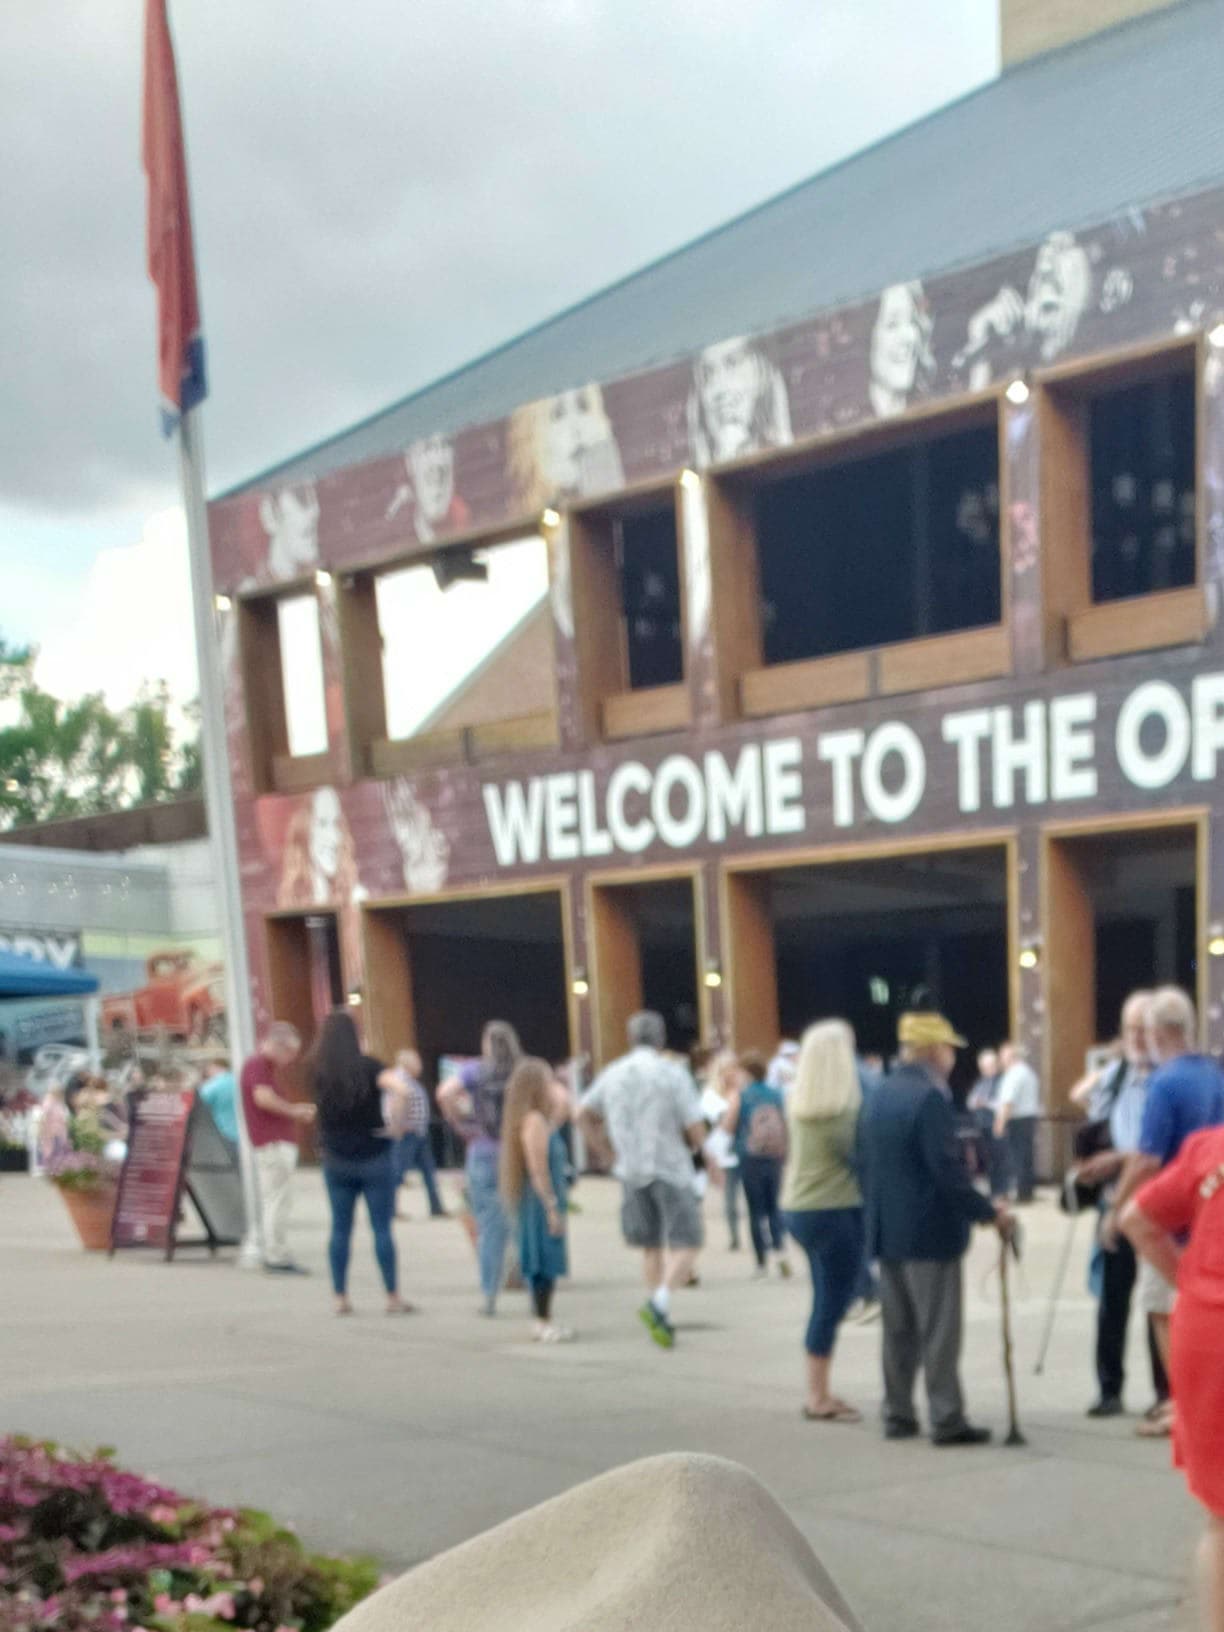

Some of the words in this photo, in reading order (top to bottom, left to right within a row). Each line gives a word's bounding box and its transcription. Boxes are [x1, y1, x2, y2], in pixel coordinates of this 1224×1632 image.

[483, 736, 804, 866] WELCOME
[818, 721, 926, 827] TO
[941, 690, 1098, 813] THE
